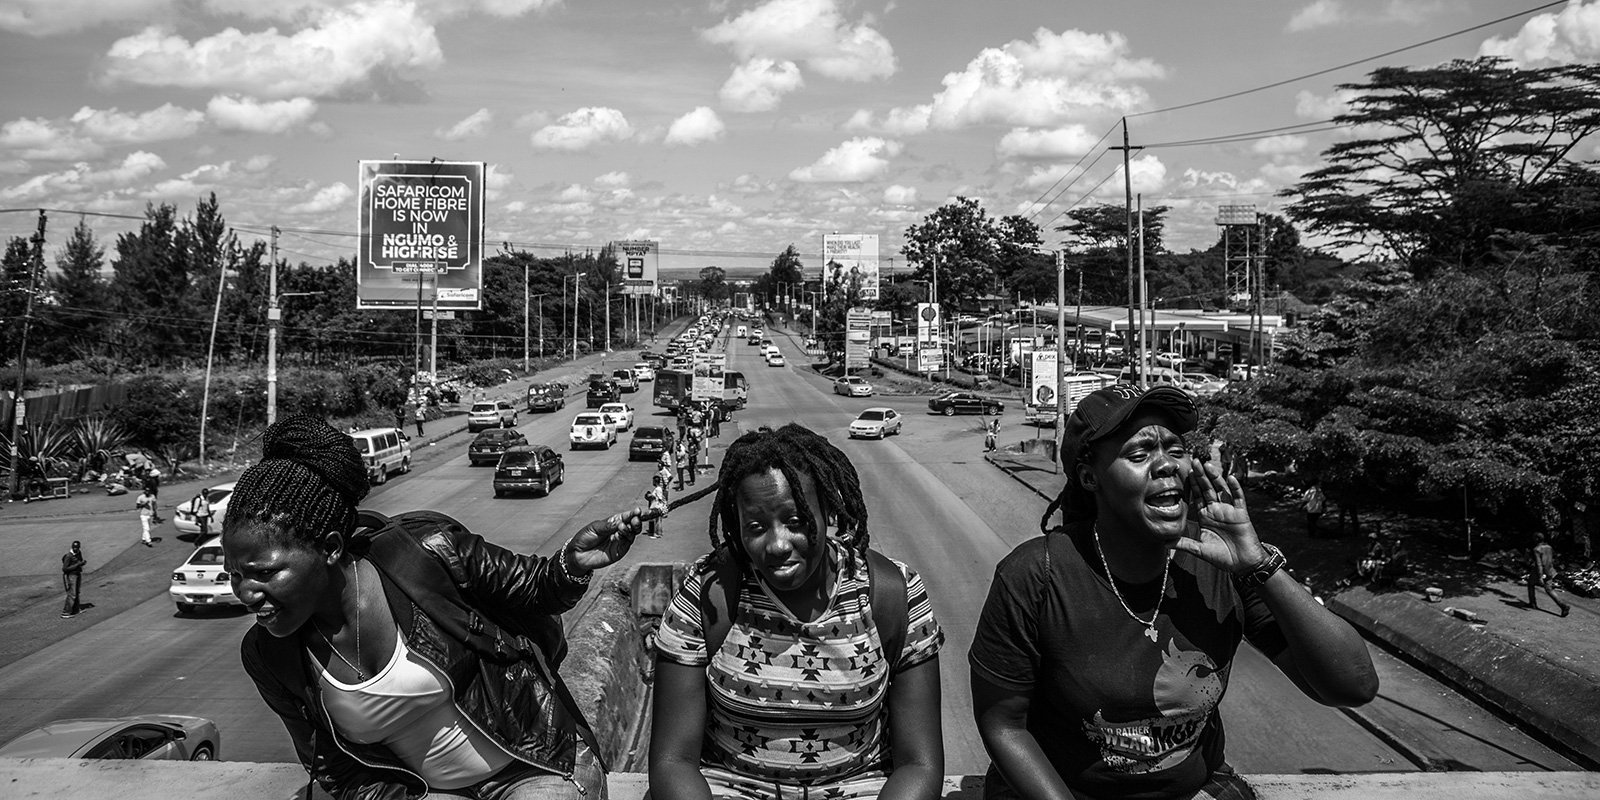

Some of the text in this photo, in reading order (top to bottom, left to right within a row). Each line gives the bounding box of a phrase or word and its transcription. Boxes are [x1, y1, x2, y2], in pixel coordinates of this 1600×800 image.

[376, 185, 464, 198] SAFARICOM
[374, 197, 467, 211] HOME FIBRE
[393, 210, 449, 223] IS NOW
[412, 222, 428, 234] IN
[383, 233, 458, 247] NGUMO &
[382, 246, 458, 259] HIGHRISE
[1115, 726, 1150, 737] RATHER
[1104, 734, 1152, 753] WEAR
